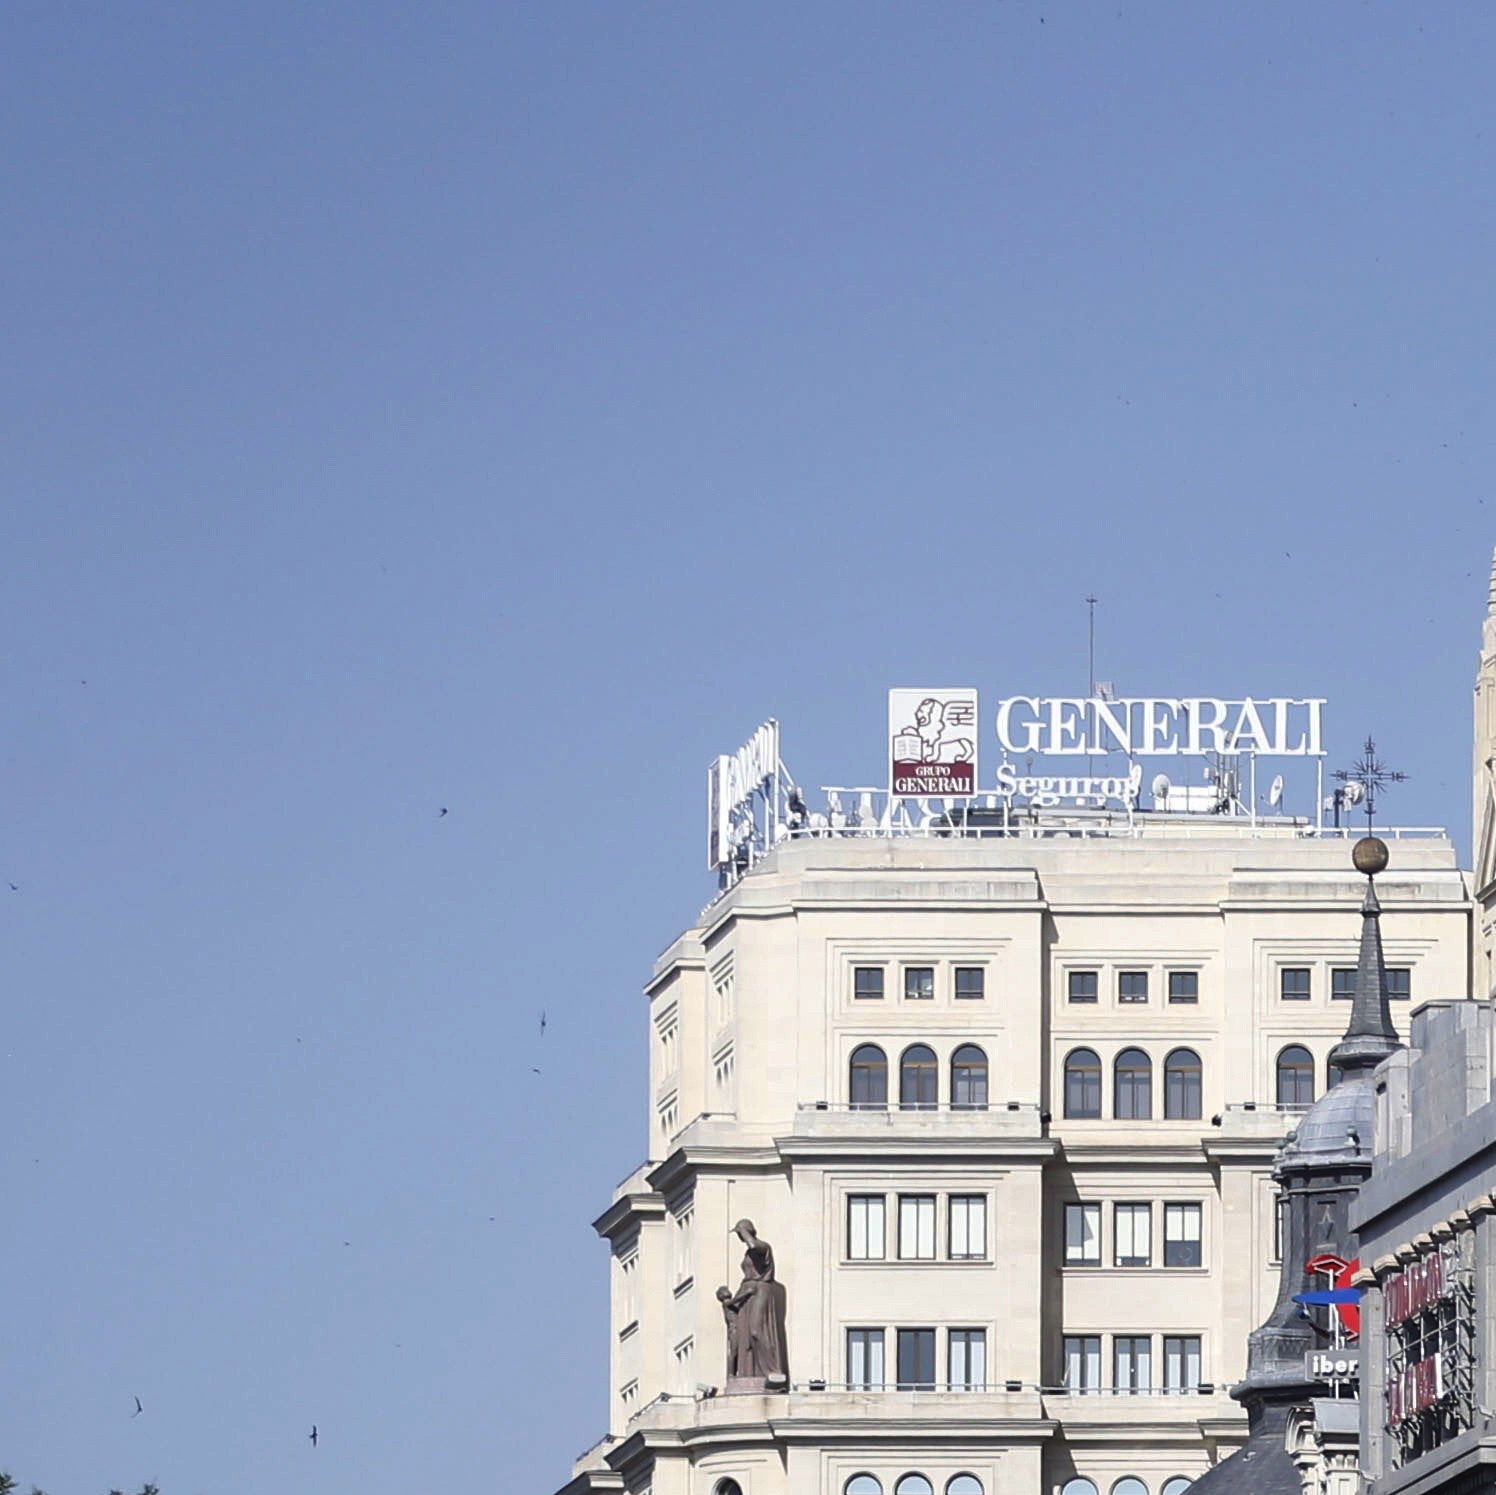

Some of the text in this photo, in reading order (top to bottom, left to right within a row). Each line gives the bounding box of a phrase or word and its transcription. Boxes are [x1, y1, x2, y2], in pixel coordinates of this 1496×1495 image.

[997, 696, 1328, 755] GENERALI
[915, 766, 951, 776] GRUPO
[895, 777, 972, 793] GENERALI
[996, 764, 1140, 806] Seguros
[1312, 1355, 1359, 1373] iber
